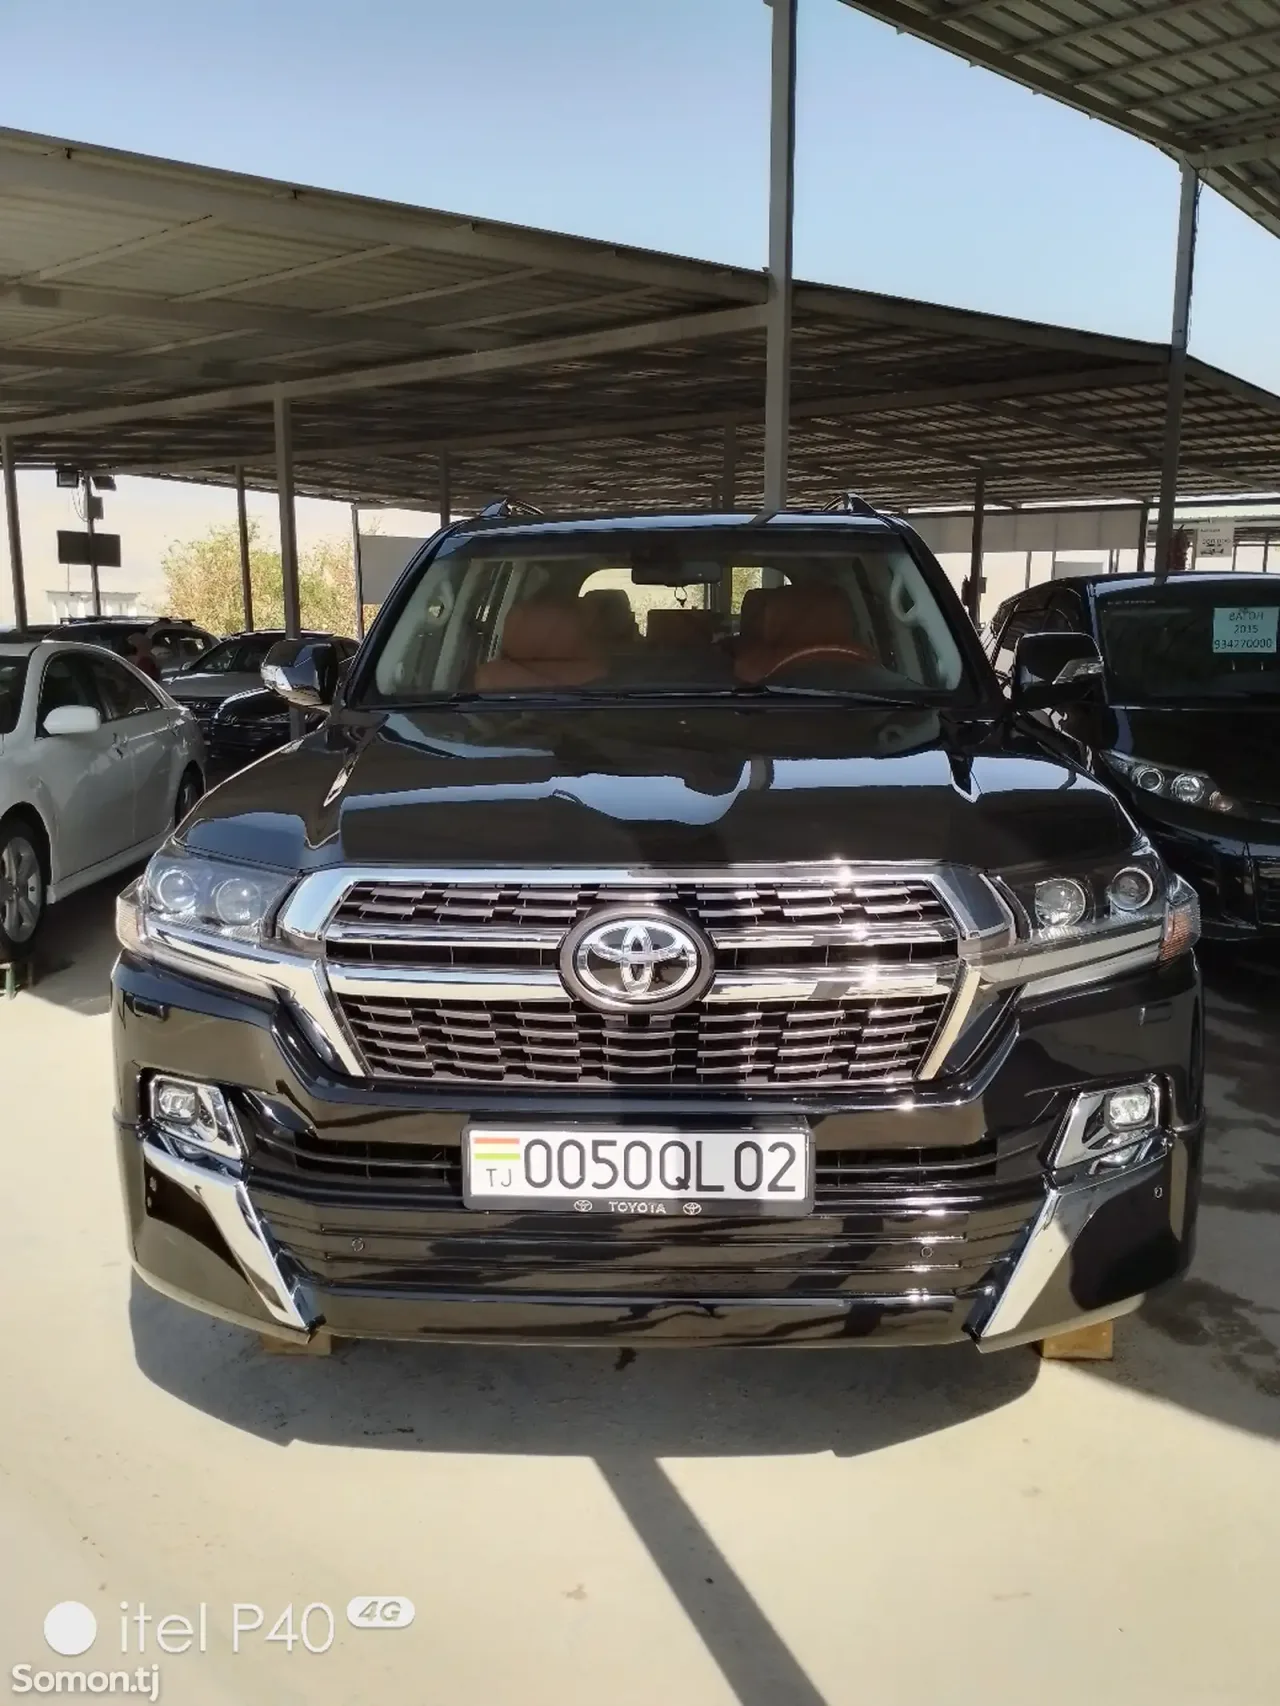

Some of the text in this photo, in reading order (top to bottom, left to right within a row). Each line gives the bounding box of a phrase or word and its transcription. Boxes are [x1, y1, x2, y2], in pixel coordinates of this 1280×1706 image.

[1234, 625, 1259, 634] 2015
[485, 1168, 512, 1188] TJ
[608, 1201, 667, 1214] TOYOTA
